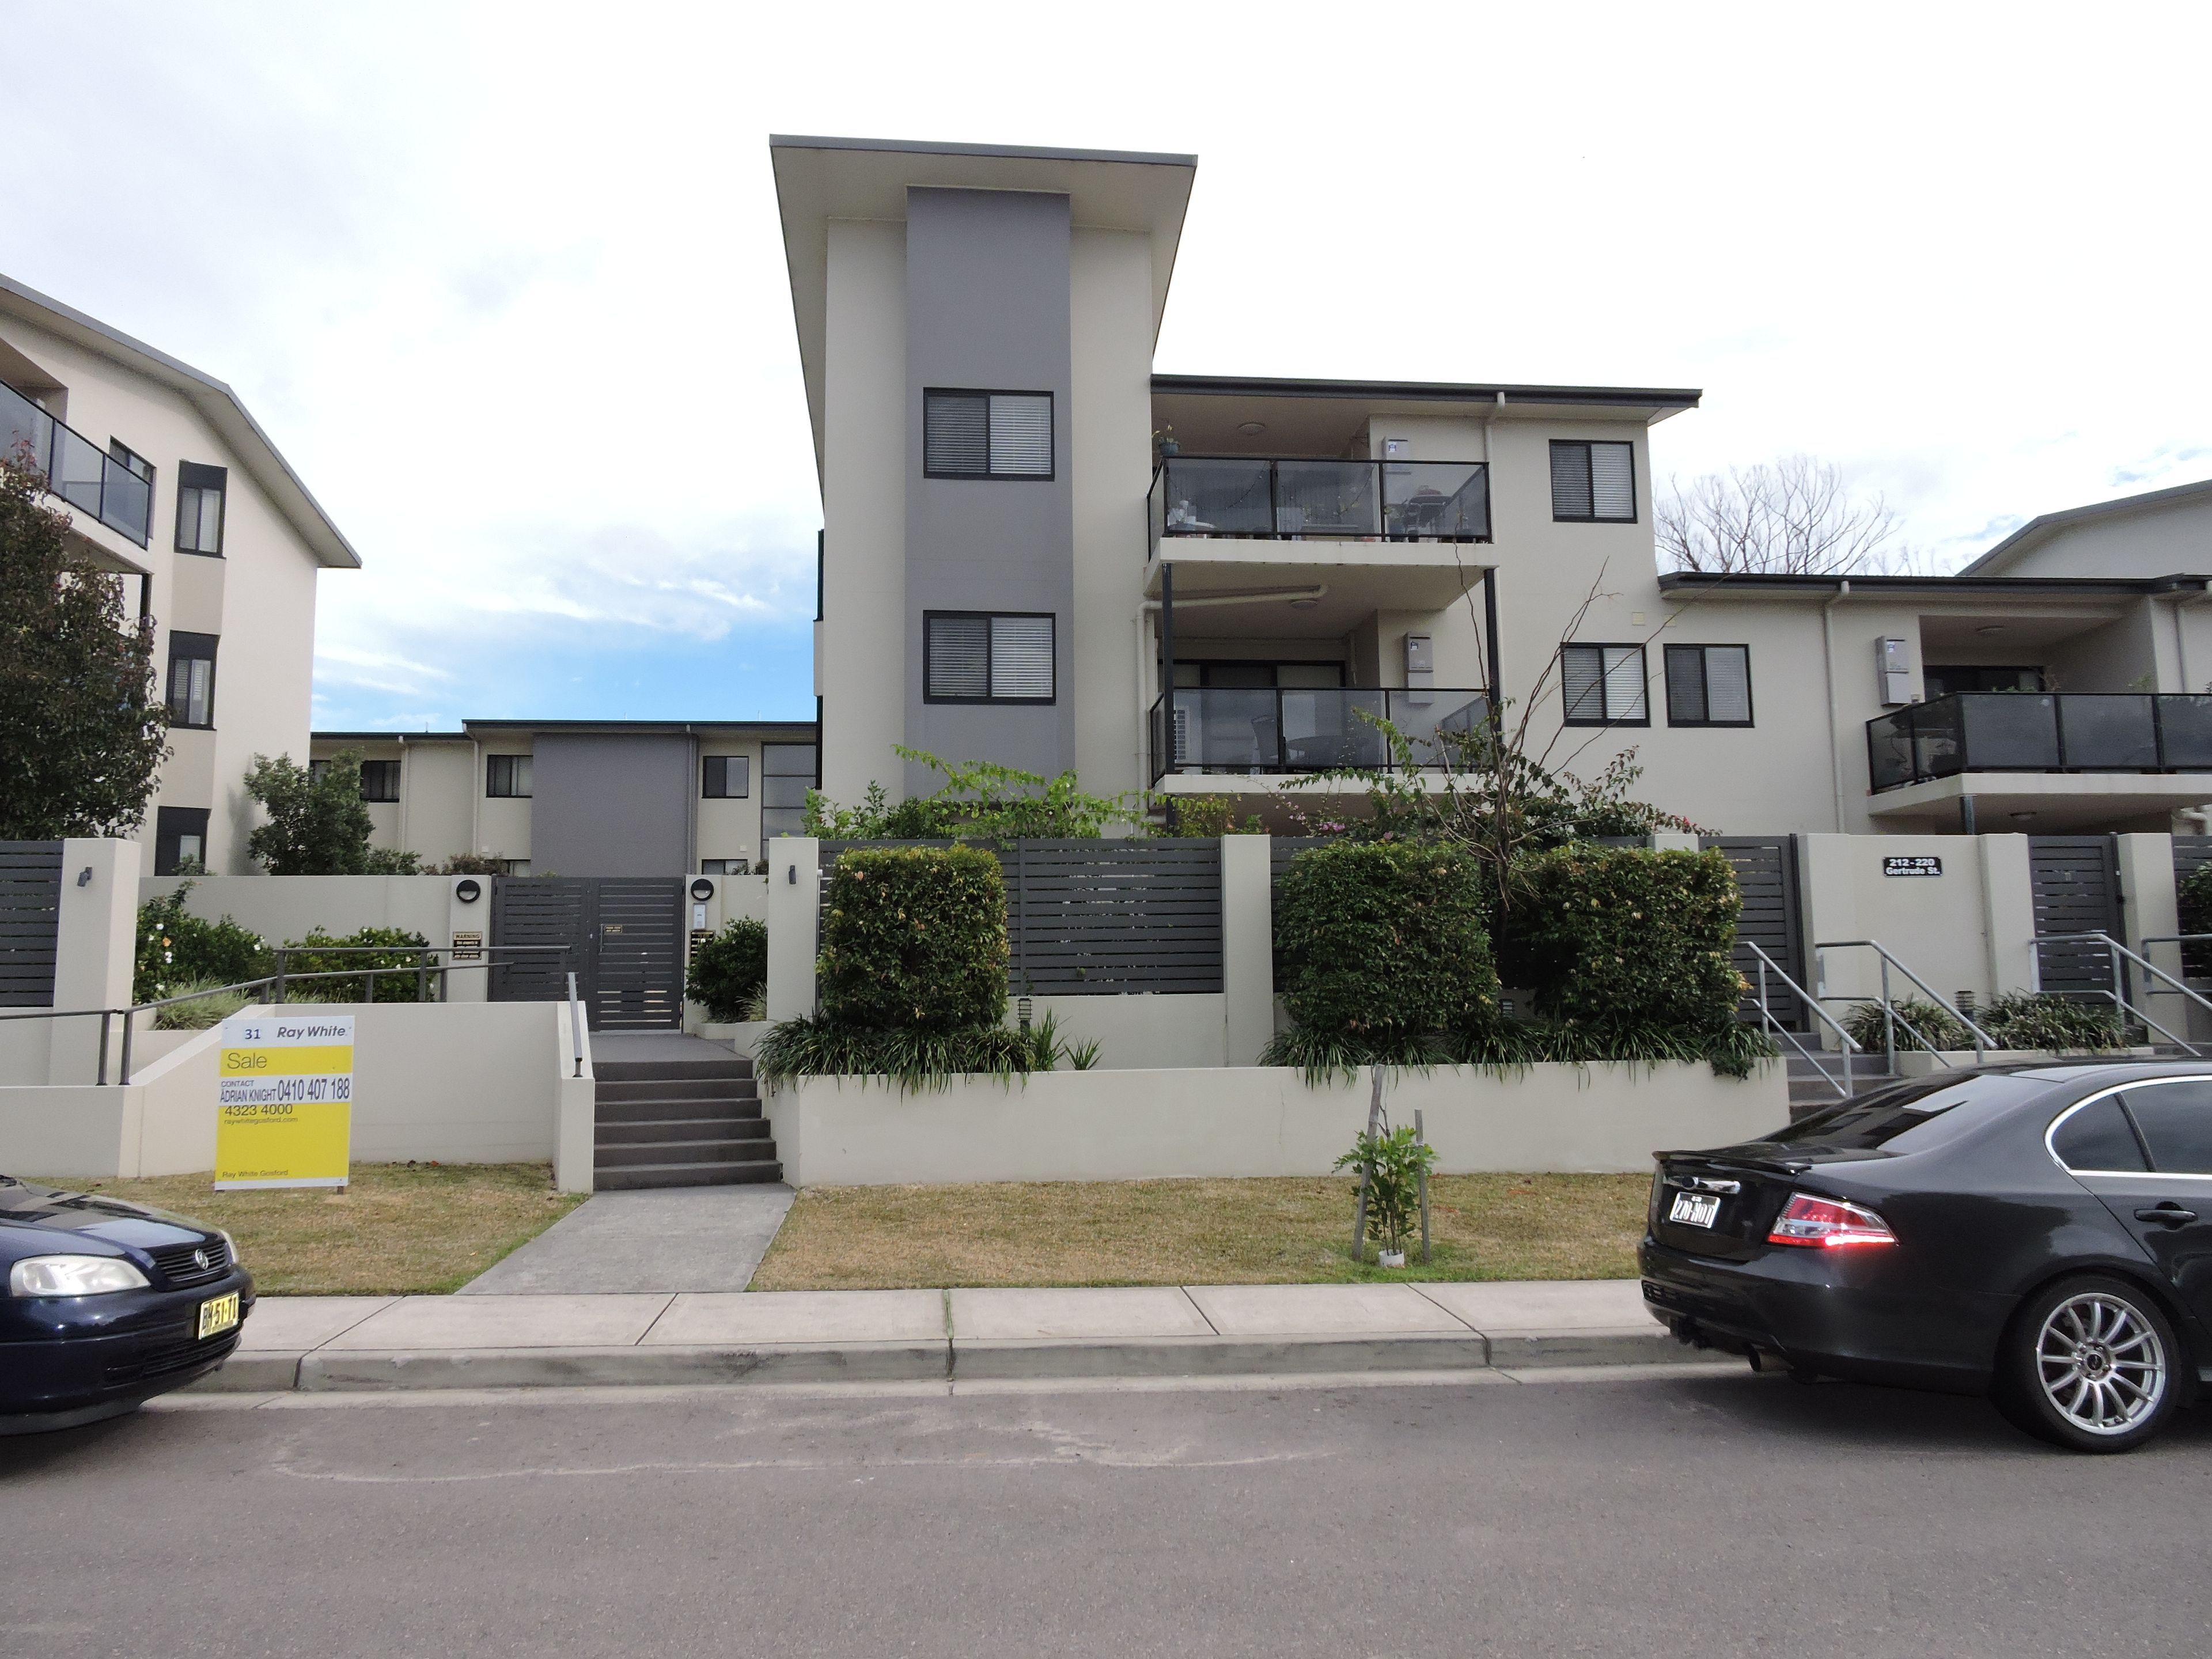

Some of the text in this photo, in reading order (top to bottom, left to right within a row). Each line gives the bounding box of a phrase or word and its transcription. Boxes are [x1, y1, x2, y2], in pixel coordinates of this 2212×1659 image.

[245, 1029, 261, 1040] 31
[277, 1025, 346, 1040] Ray White
[227, 1052, 267, 1069] Sale
[220, 1078, 350, 1103] ADRIAN KNIGHT 0410 407 188
[225, 1103, 293, 1116] 4323 4000
[260, 1168, 289, 1176] Gosford
